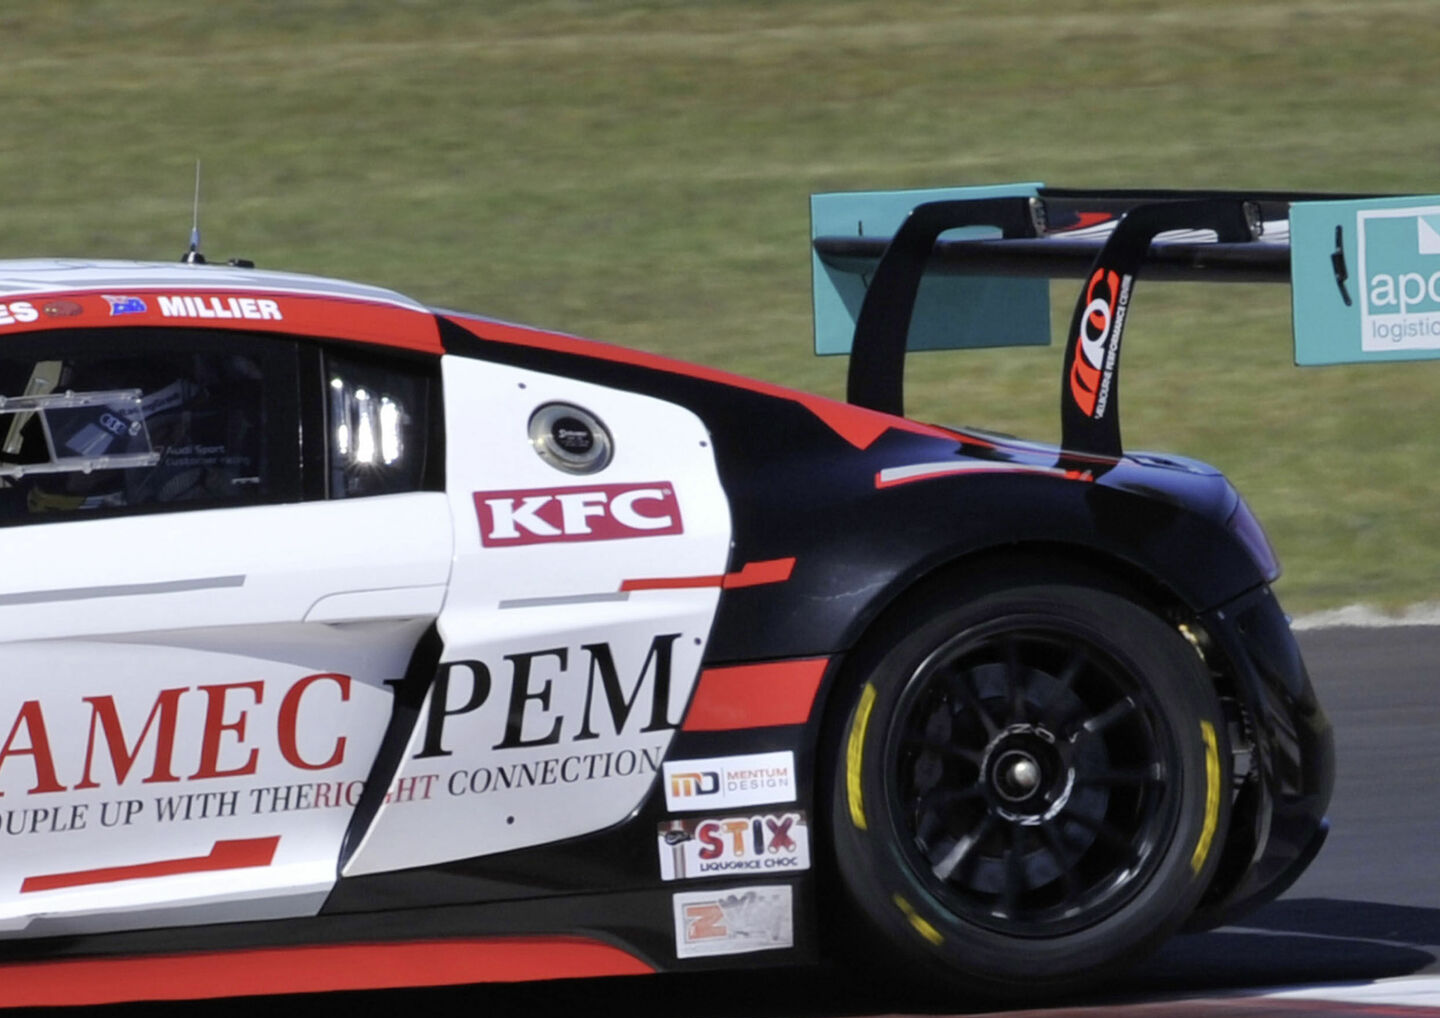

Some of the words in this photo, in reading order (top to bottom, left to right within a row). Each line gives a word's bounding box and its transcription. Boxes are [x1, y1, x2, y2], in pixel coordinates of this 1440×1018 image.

[157, 296, 283, 322] MILLIER
[1372, 318, 1440, 342] logistic
[484, 488, 673, 540] KFC
[412, 633, 682, 760] PEM
[99, 799, 144, 828] UP
[154, 790, 241, 823] WITH
[448, 746, 662, 797] CONNECTION
[727, 767, 788, 781] MENTUM
[727, 778, 789, 791] DESIGN
[698, 815, 797, 860] STIX
[764, 857, 799, 868] CHOC
